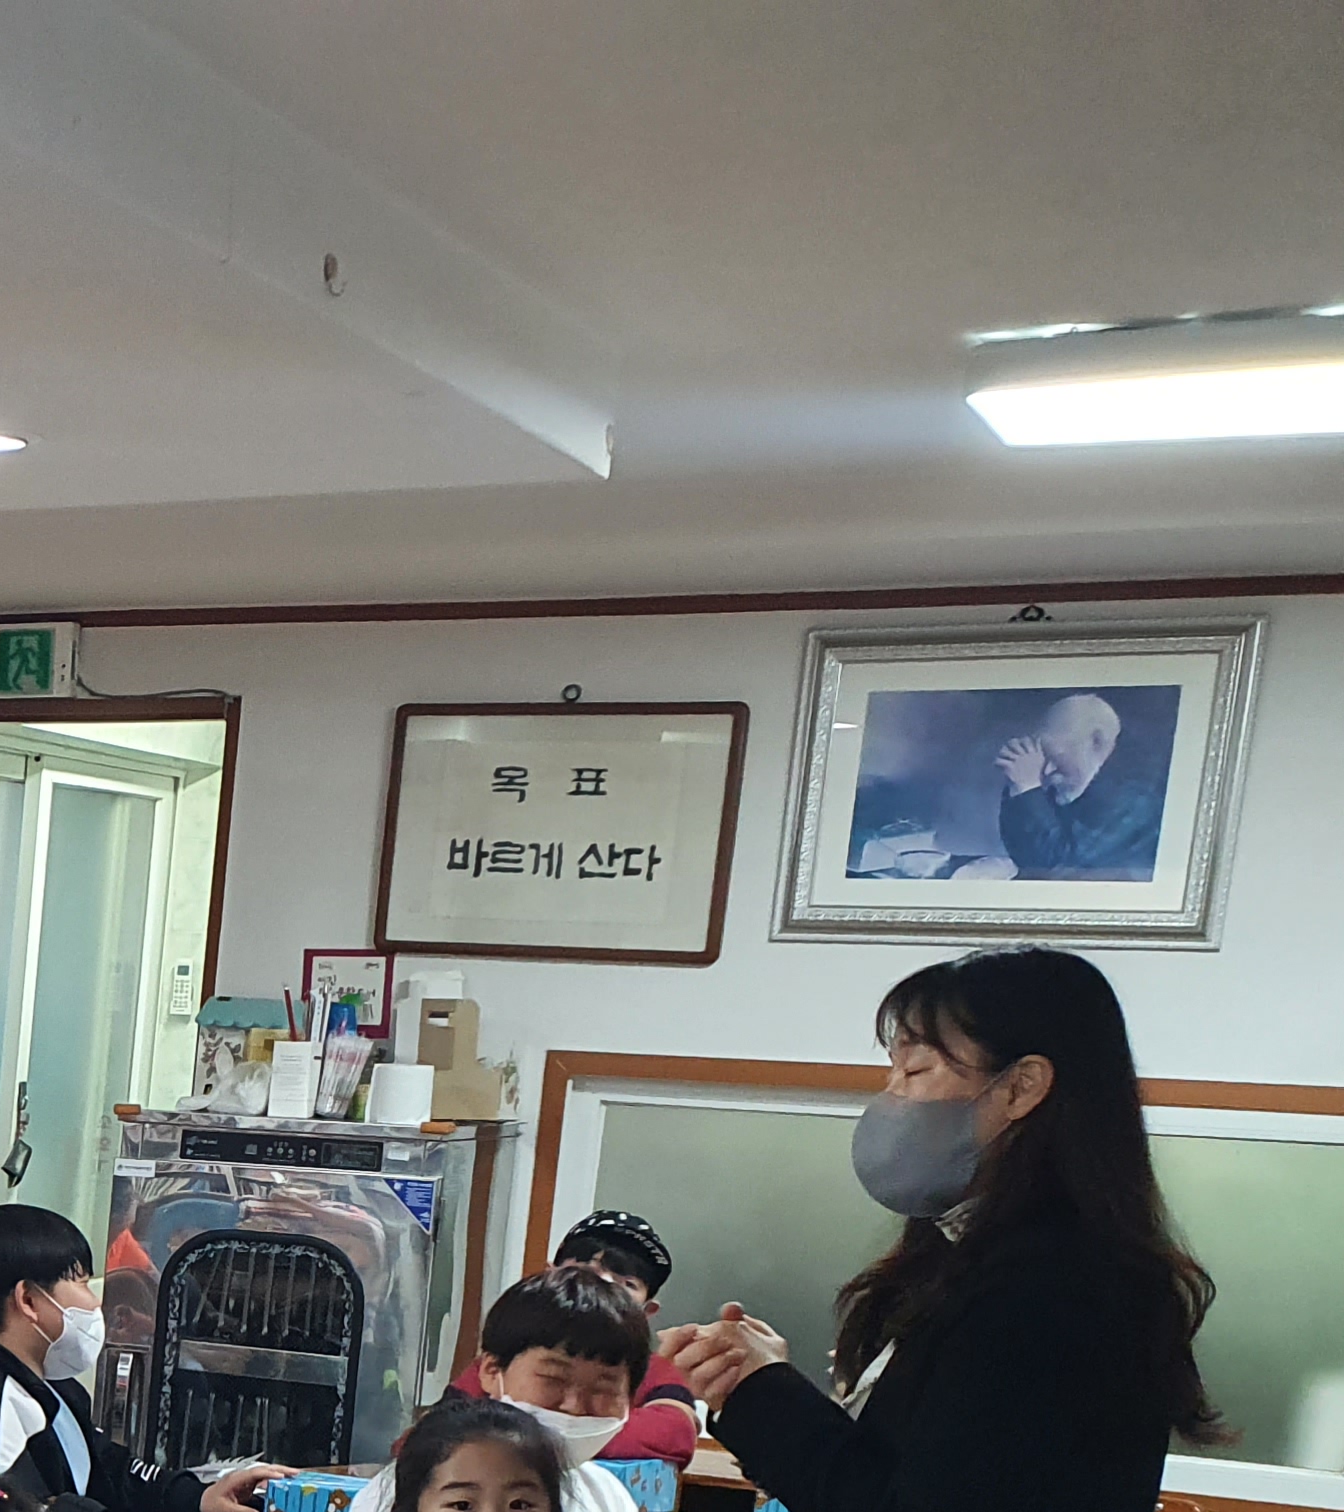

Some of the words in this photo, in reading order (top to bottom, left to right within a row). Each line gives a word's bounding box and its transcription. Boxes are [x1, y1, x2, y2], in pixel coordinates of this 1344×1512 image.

[491, 766, 530, 803] 목
[566, 768, 609, 796] 표
[447, 836, 563, 879] 바르게
[578, 842, 662, 881] 산다
